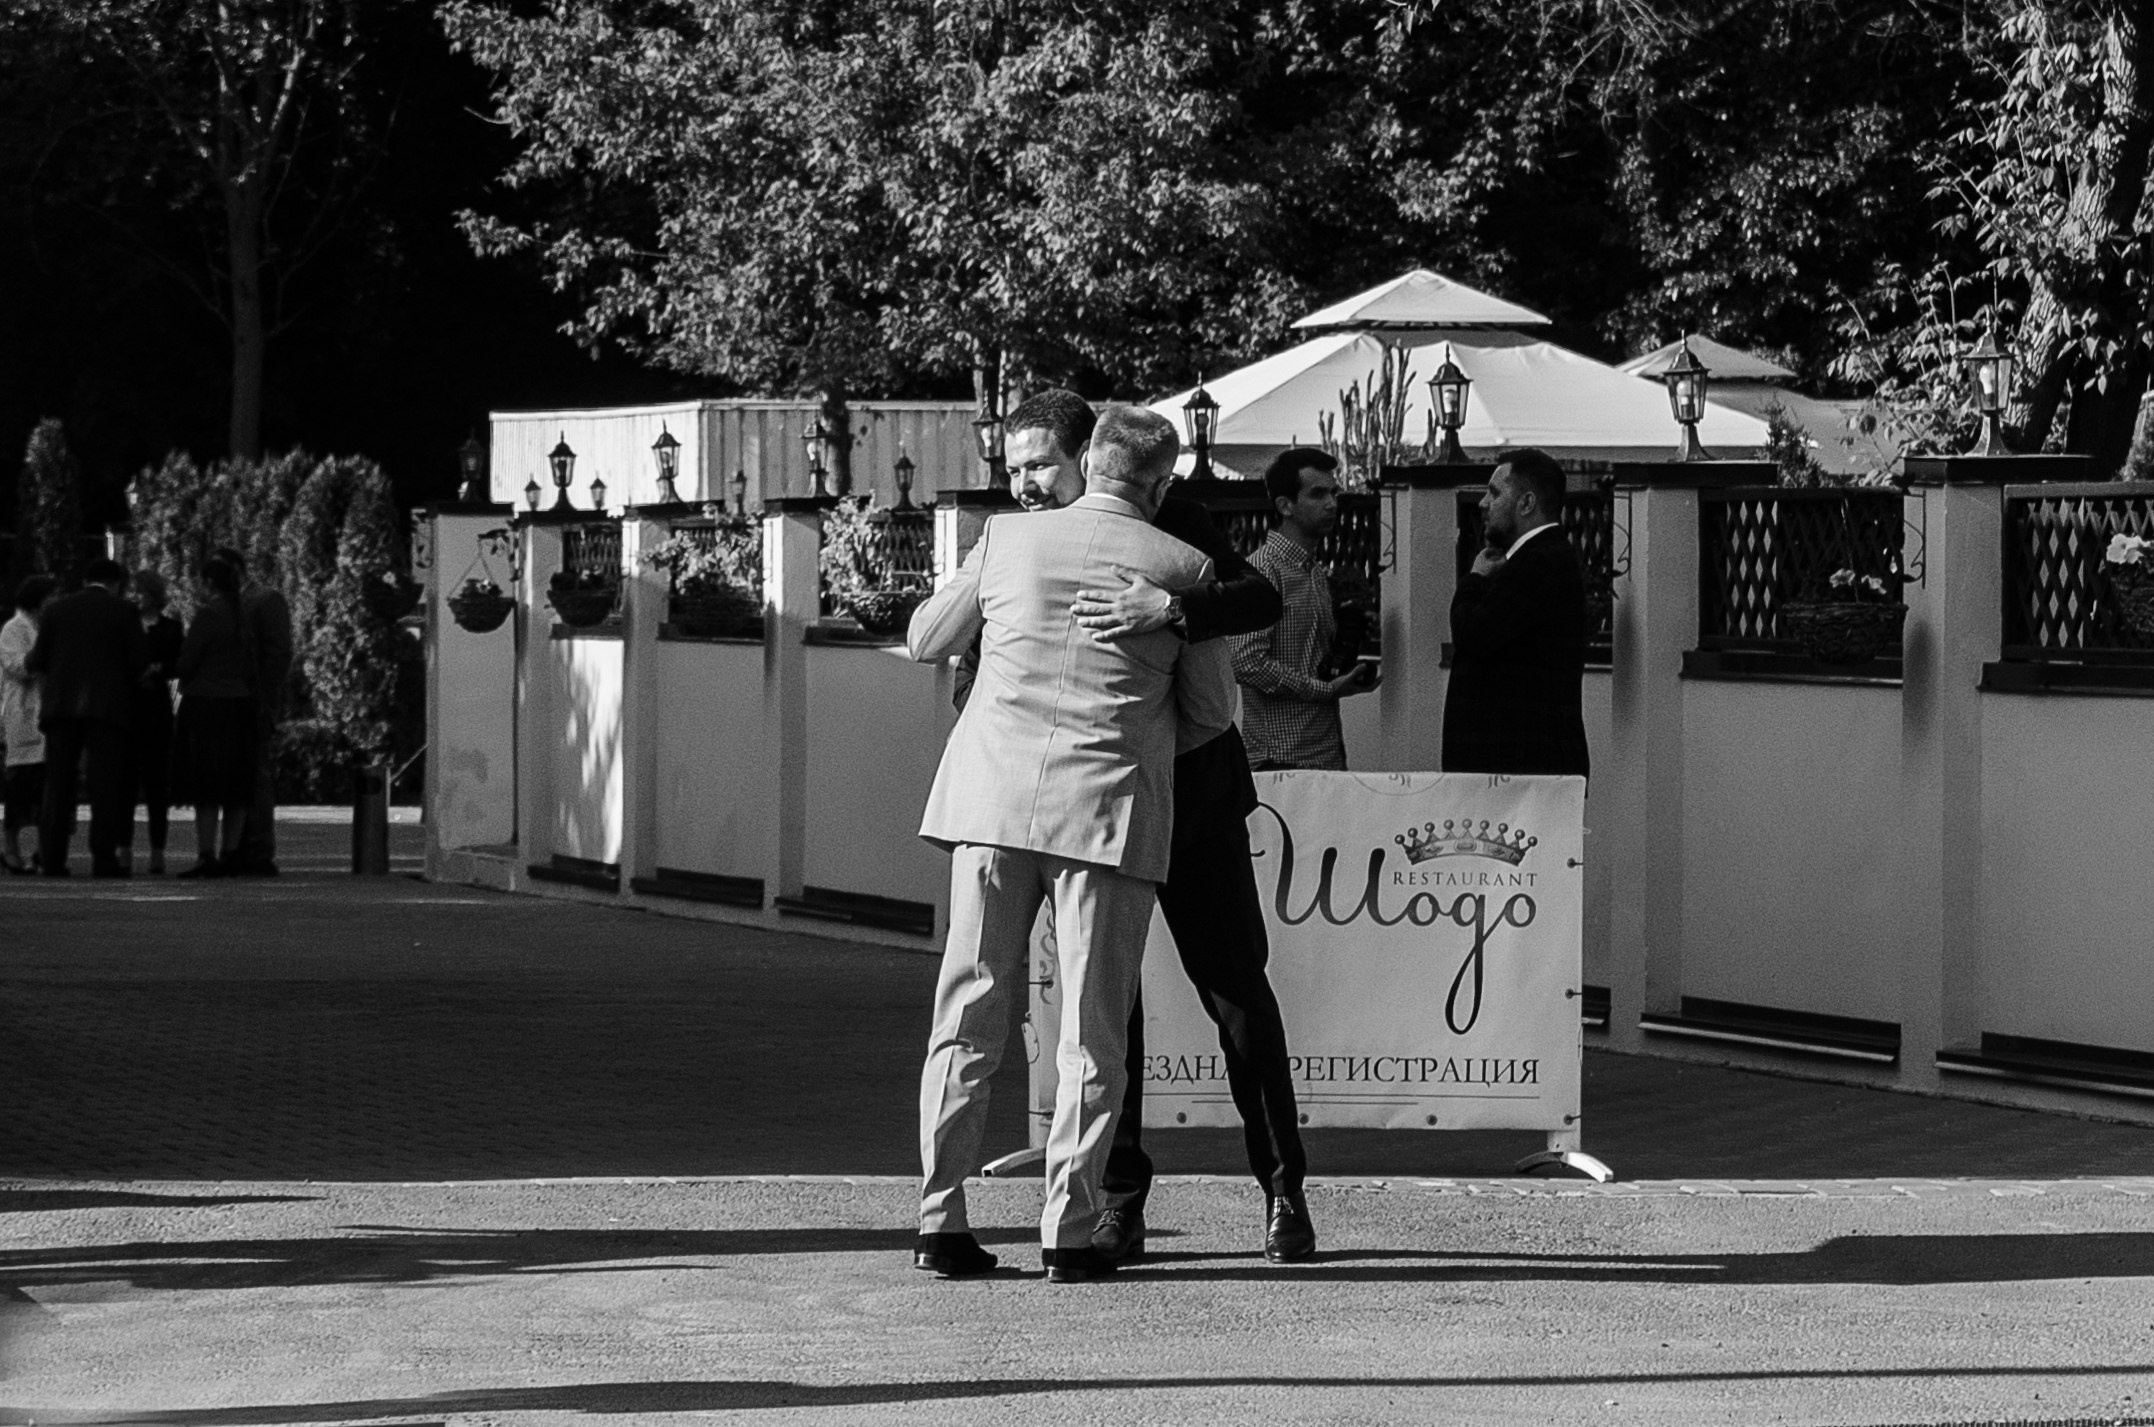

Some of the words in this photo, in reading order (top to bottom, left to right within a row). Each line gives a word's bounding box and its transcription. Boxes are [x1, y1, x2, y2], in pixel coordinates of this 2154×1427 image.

[1393, 871, 1538, 887] RESTAURANT
[1143, 1055, 1228, 1085] ЕЗДН
[1287, 1056, 1540, 1088] РЕГИСТРАЦИЯ
